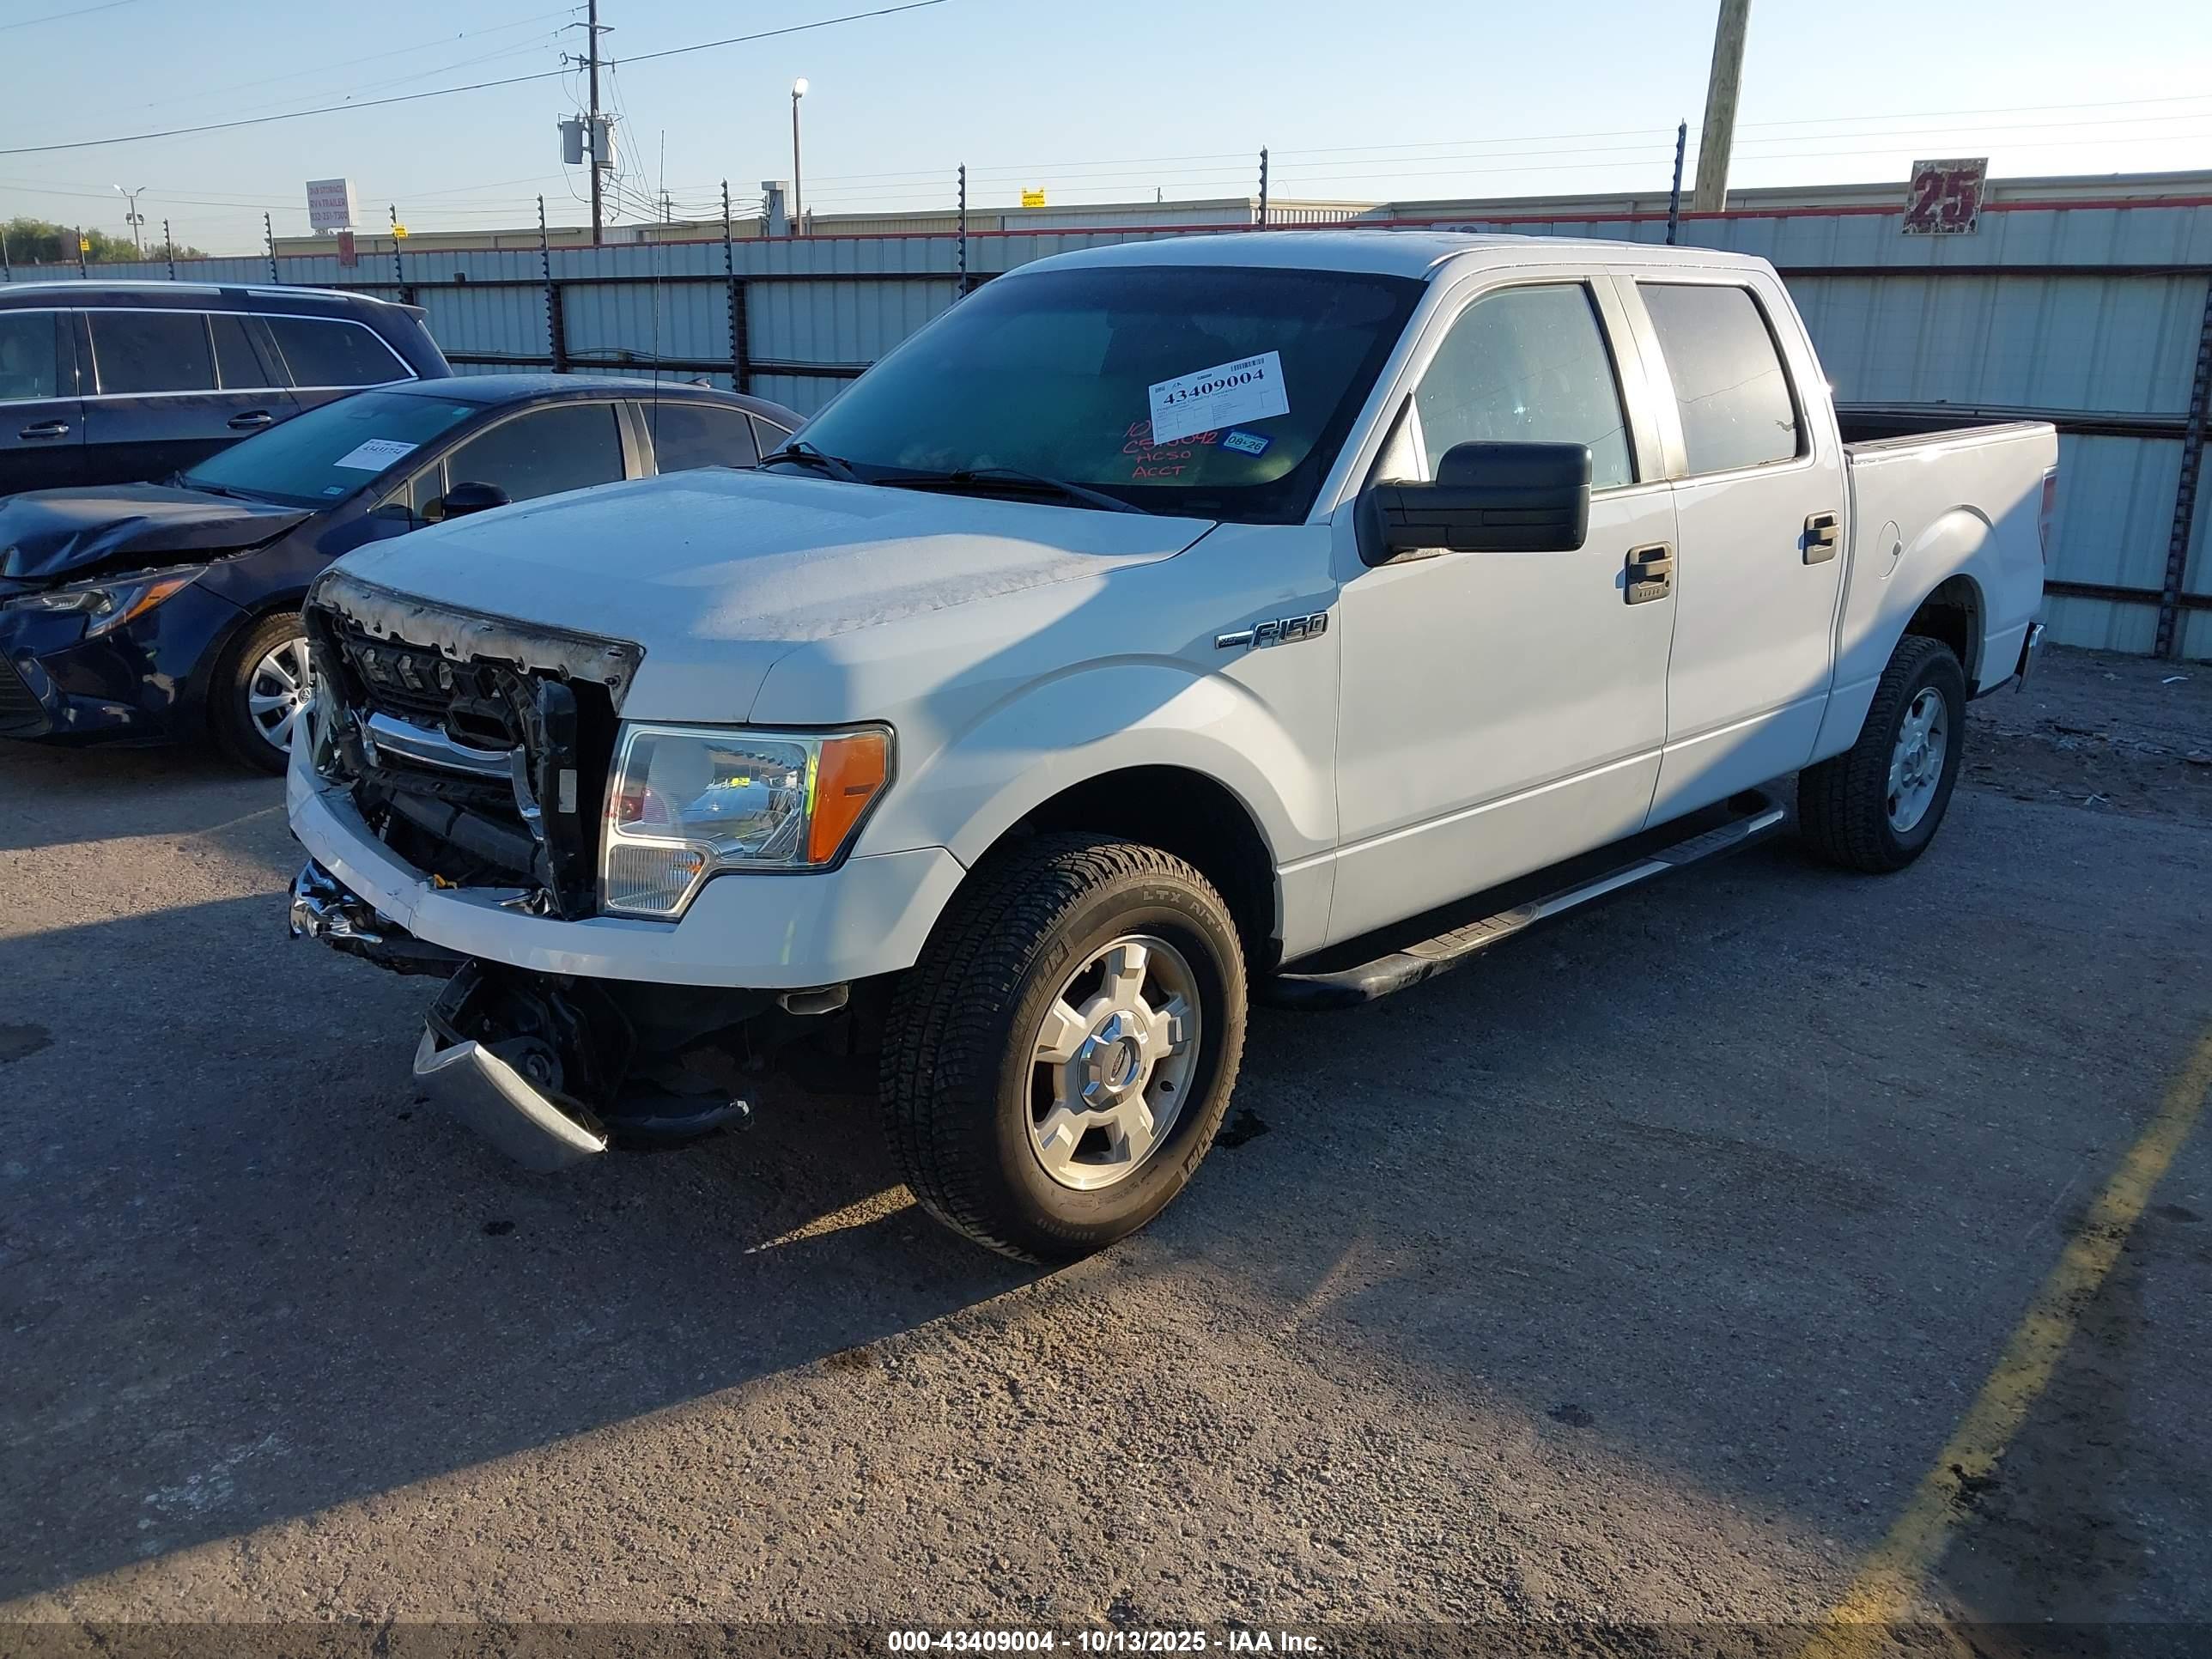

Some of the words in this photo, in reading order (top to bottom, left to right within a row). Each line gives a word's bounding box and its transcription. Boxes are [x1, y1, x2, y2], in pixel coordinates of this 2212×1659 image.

[1908, 169, 1981, 226] 25
[1163, 368, 1265, 404] 43409004
[1228, 435, 1244, 446] 08
[1247, 441, 1263, 451] 26
[1135, 450, 1192, 464] HCSO
[1131, 465, 1187, 478] ACCT
[1143, 890, 1182, 903] LTX
